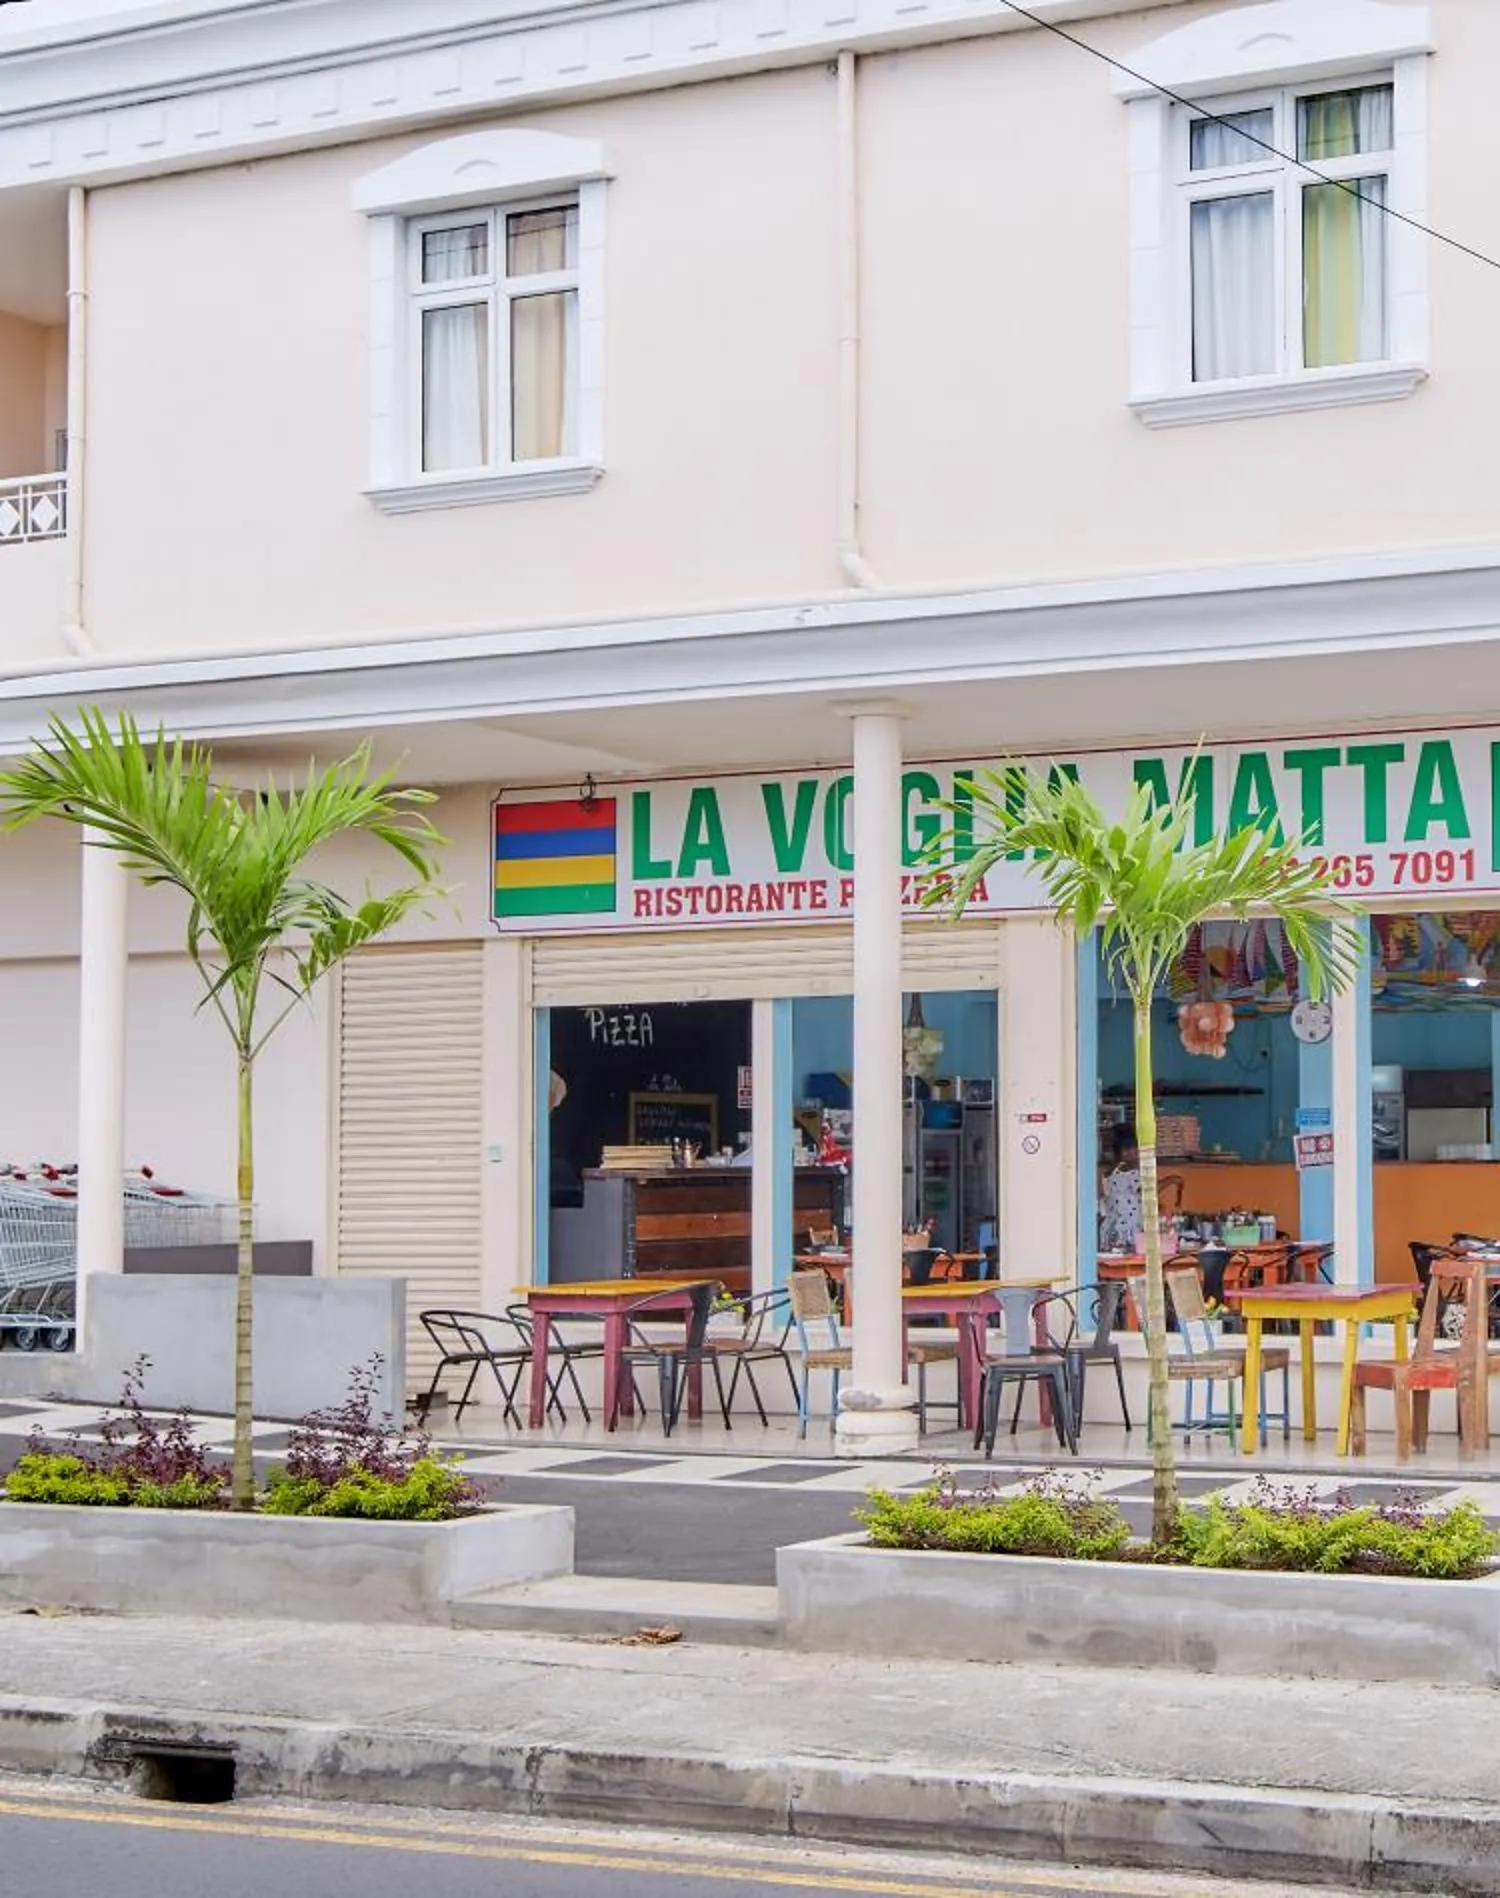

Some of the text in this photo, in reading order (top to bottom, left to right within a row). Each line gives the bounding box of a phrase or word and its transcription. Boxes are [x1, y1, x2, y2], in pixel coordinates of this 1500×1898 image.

[632, 740, 1471, 880] LA VOGLI MATTA
[1389, 848, 1475, 885] 7091
[633, 880, 827, 917] RISTORANTE
